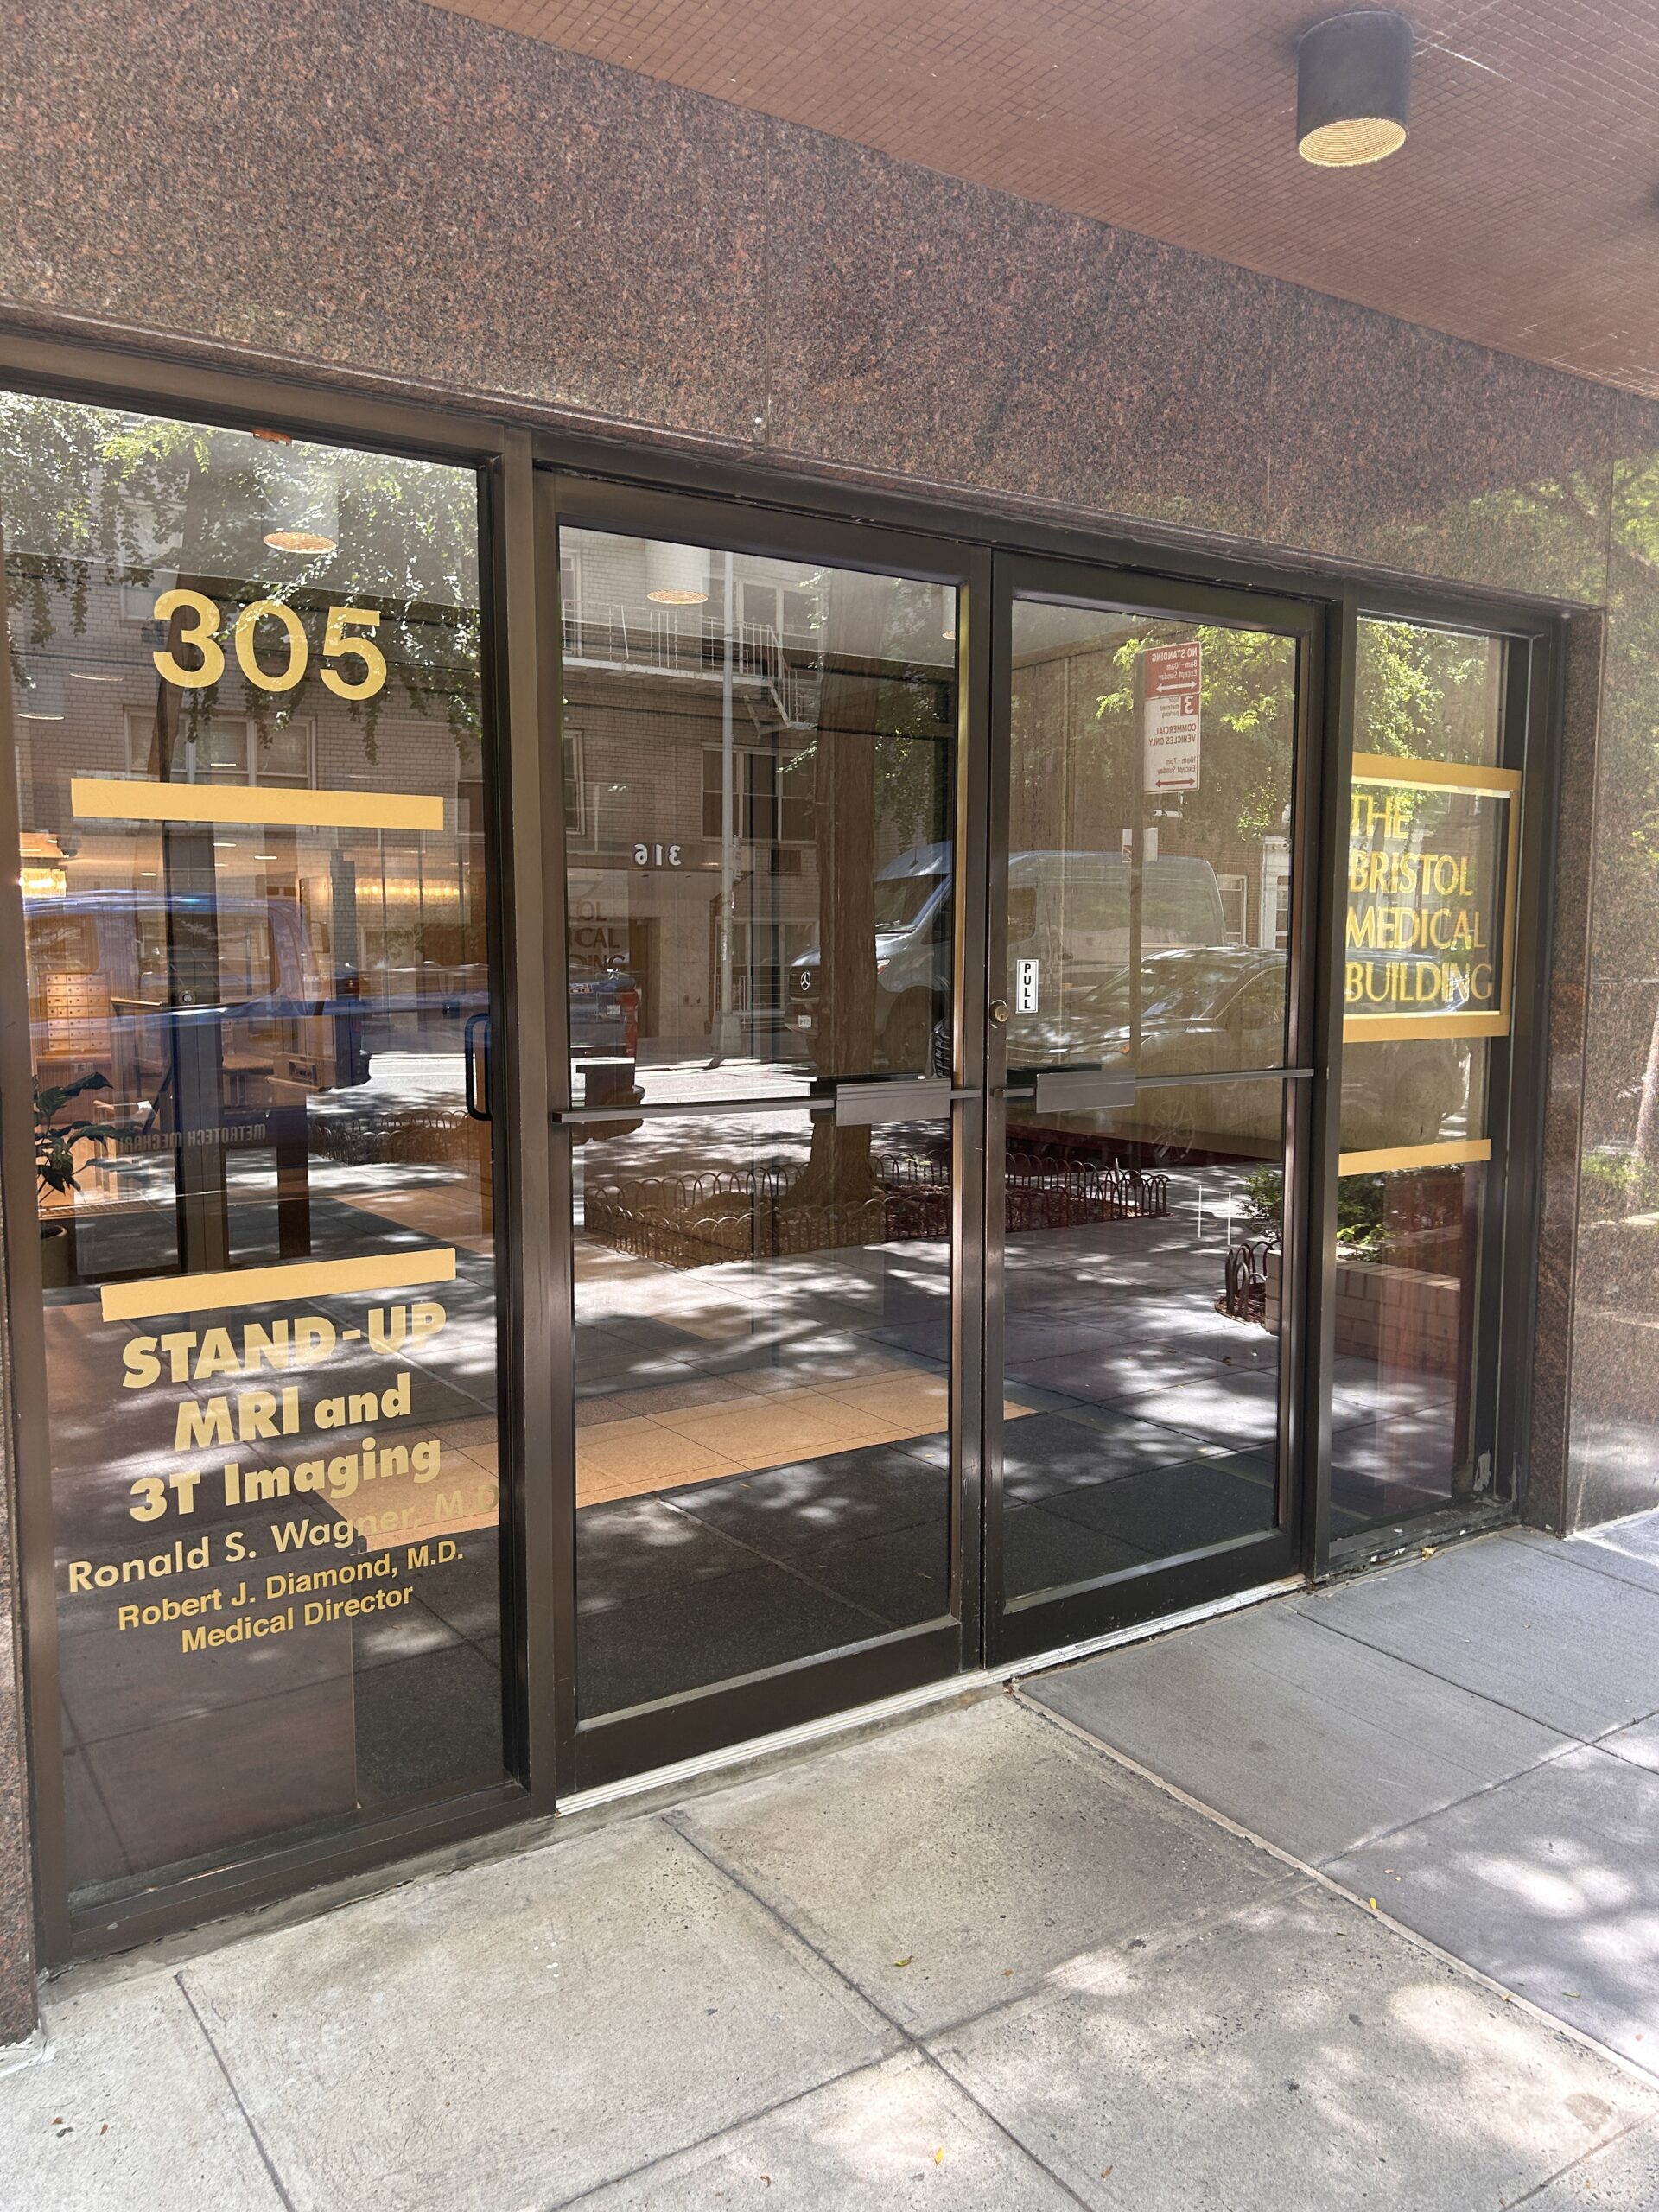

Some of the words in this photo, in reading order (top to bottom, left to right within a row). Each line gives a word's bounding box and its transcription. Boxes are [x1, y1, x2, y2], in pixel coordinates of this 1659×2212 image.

[153, 588, 387, 701] 305
[1351, 794, 1410, 839] THE
[1349, 849, 1473, 896] BRISTOL
[1345, 906, 1487, 950] MEDICAL
[1023, 963, 1032, 1009] PULL
[1344, 961, 1493, 1003] BUILDING
[122, 1302, 447, 1389] STAND-UP
[174, 1385, 299, 1452] MRI
[314, 1372, 411, 1429] and
[129, 1472, 201, 1522] 3T
[225, 1437, 441, 1507] Imaging
[68, 1536, 210, 1594] Ronald
[225, 1531, 257, 1563] S.
[271, 1505, 420, 1554] Wagner,
[118, 1586, 222, 1630] Robert
[231, 1582, 257, 1608] J.
[266, 1553, 398, 1601] Diamond,
[406, 1540, 464, 1571] M.D.
[181, 1608, 295, 1654] Medical
[304, 1586, 414, 1626] Director
